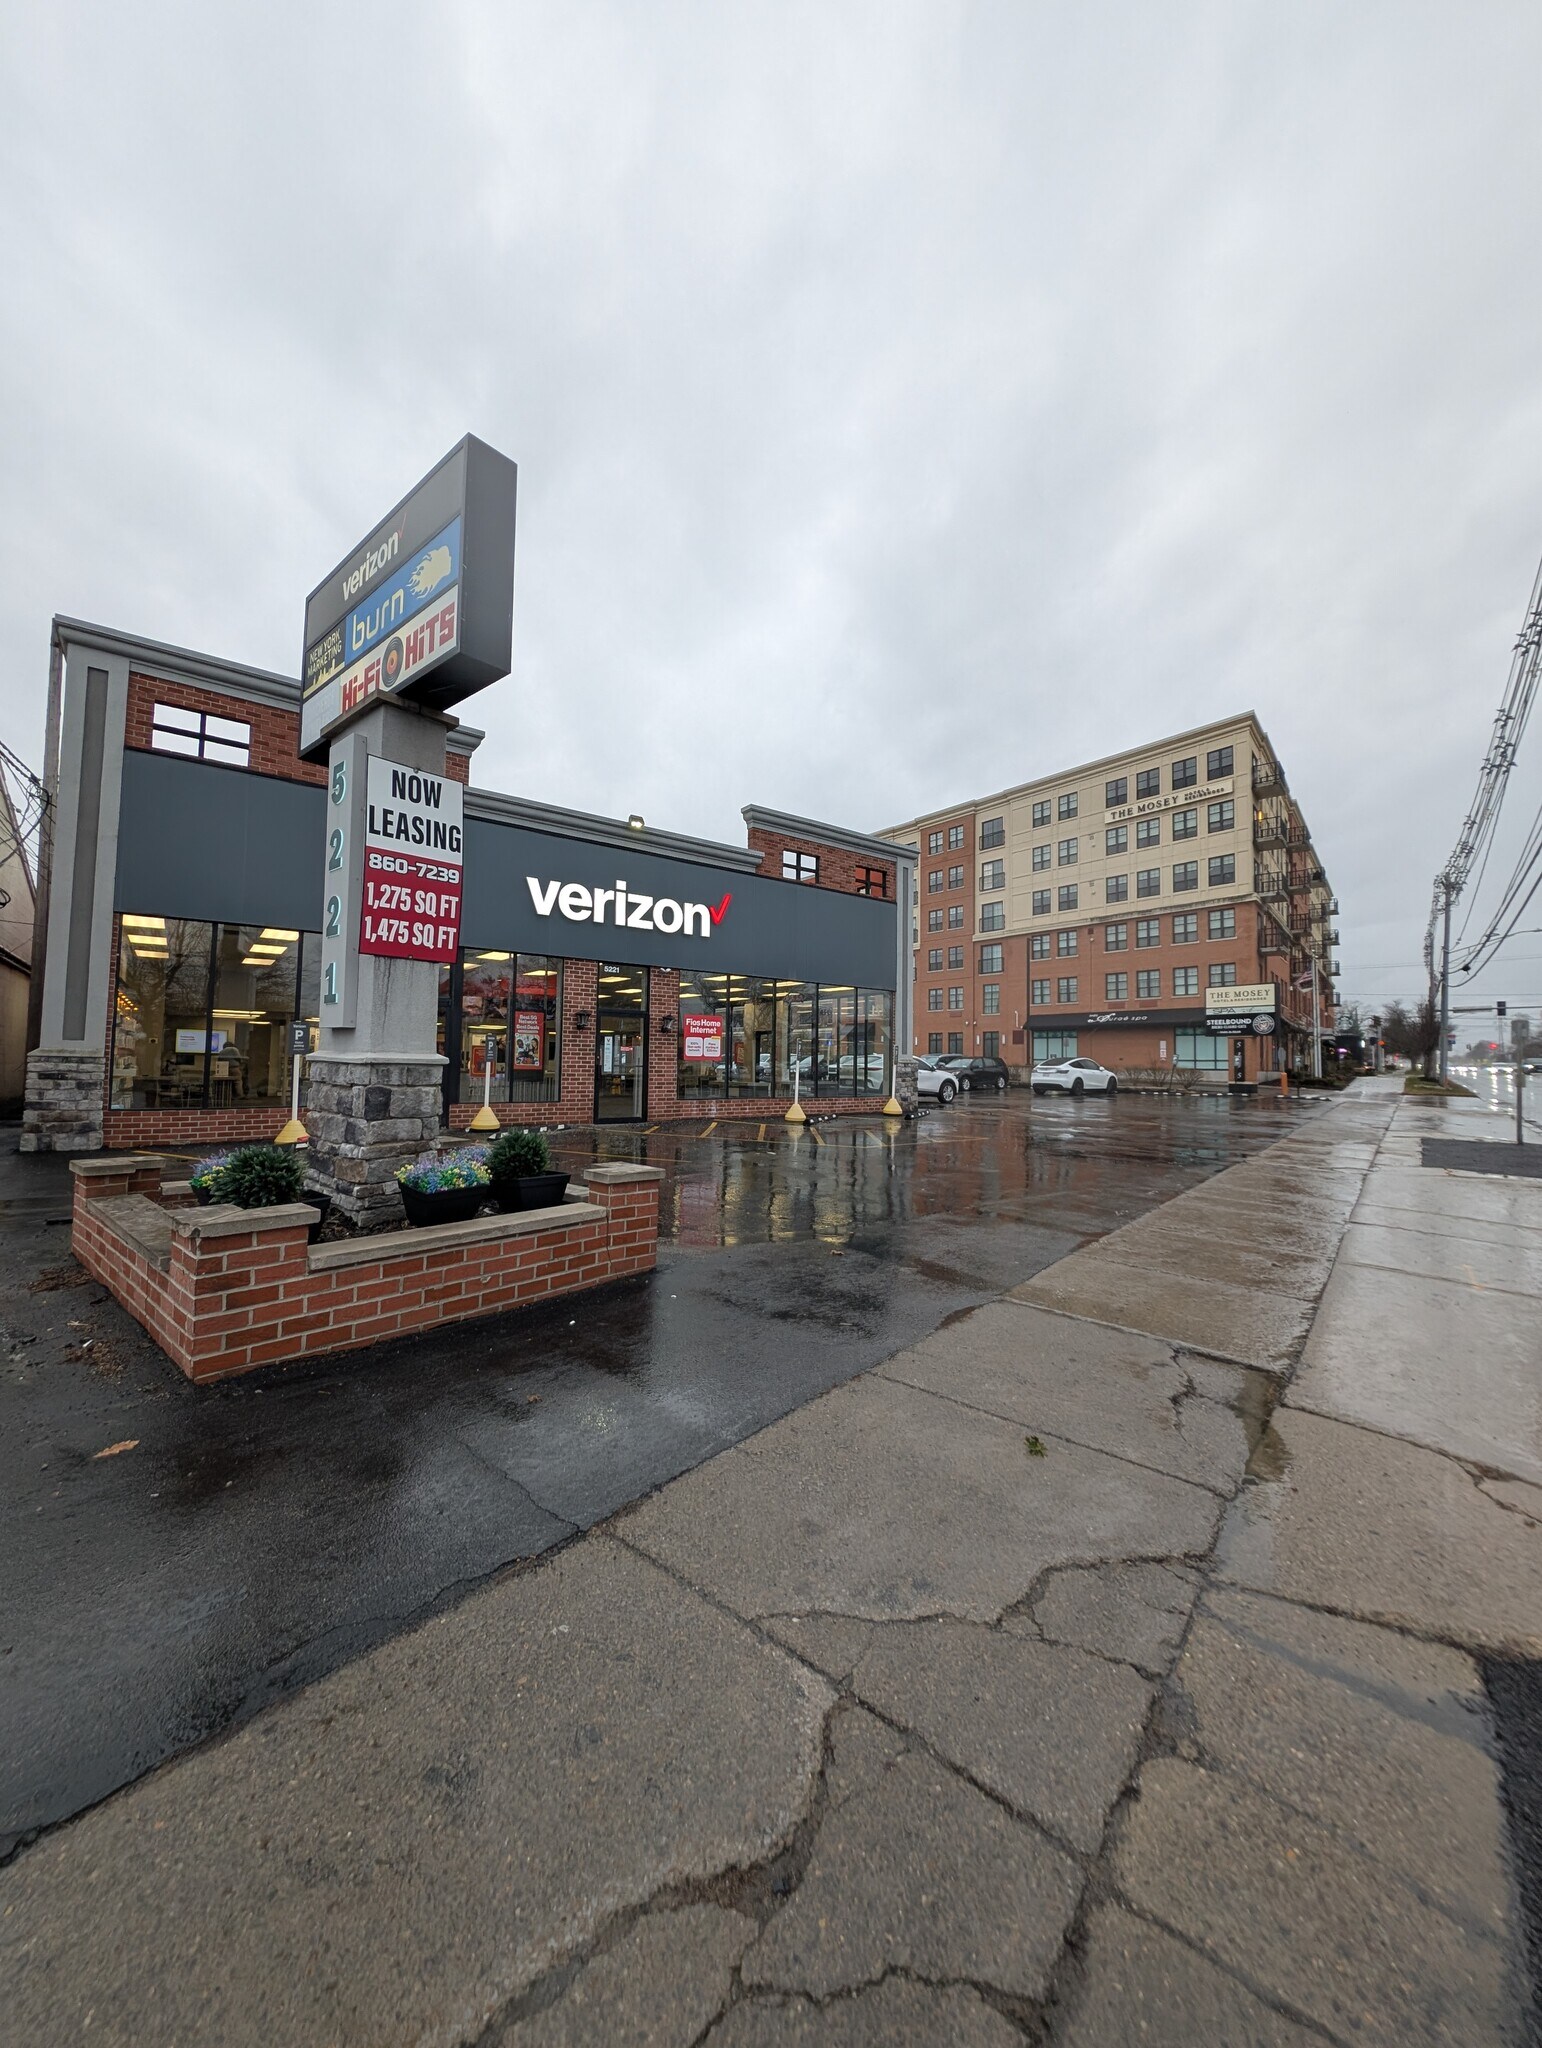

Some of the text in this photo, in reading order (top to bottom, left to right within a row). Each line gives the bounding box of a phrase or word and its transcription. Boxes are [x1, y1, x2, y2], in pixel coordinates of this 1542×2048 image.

[342, 530, 400, 602] verizon
[352, 588, 405, 651] burn
[307, 640, 342, 678] MARKETING
[309, 628, 341, 665] NEW YORK
[341, 657, 381, 714] Hi-Fi
[391, 769, 442, 809] NOW
[1111, 796, 1179, 820] THE MOSEY
[368, 805, 461, 853] LEASING
[368, 853, 460, 884] 860-7239
[367, 881, 459, 919] 1,275 SQ FT
[526, 876, 711, 938] verizon
[364, 915, 457, 950] 1,475 SQ FT
[603, 965, 620, 974] 5221
[1210, 989, 1271, 999] THE MOSEY
[295, 1030, 304, 1040] P
[686, 1018, 721, 1027] Fios Home
[690, 1026, 717, 1034] Internet
[488, 1041, 494, 1050] P
